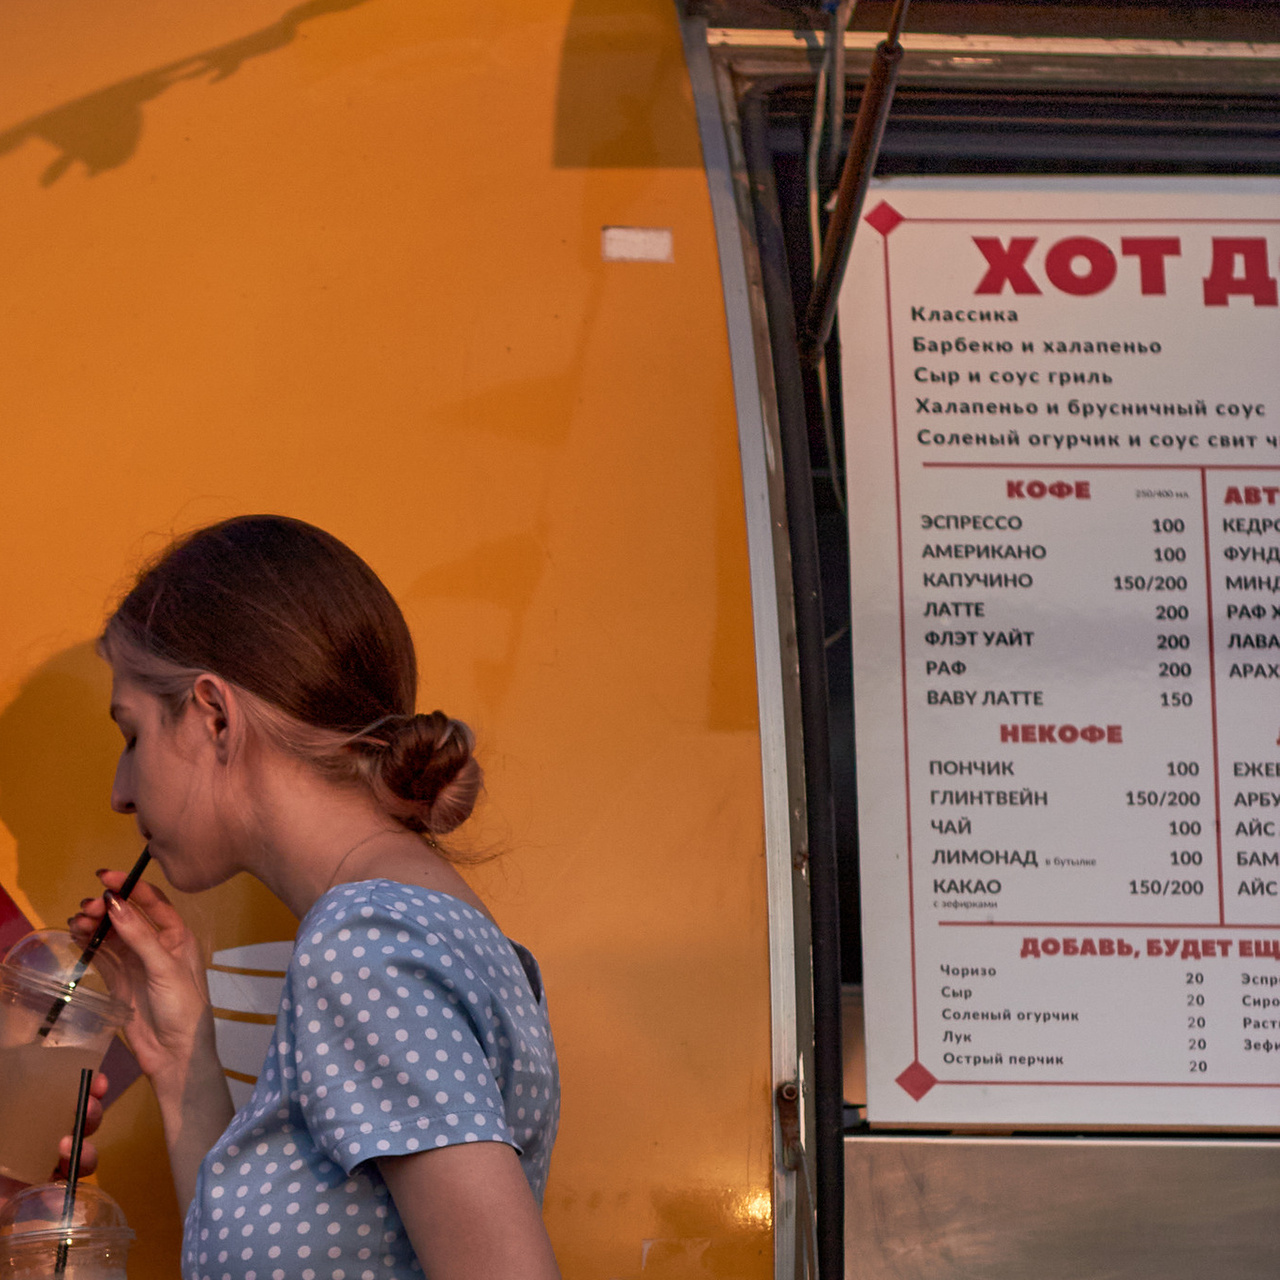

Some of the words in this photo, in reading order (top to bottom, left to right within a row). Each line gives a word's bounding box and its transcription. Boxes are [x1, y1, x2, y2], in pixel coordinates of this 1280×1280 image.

[971, 235, 1182, 297] ХОТ
[910, 305, 1019, 323] Классика
[912, 336, 1014, 356] Барбекю
[1021, 341, 1034, 354] и
[1043, 341, 1162, 354] халапеньо
[913, 366, 960, 387] Сыр
[968, 371, 981, 383] и
[988, 371, 1039, 387] соус
[1048, 371, 1113, 387] гриль
[915, 397, 1039, 415] Халапеньо
[1046, 402, 1059, 415] и
[1067, 398, 1207, 419] брусничный
[1215, 403, 1265, 420] соус
[916, 428, 1020, 446] Соленый
[1027, 434, 1120, 450] огурчик
[1128, 434, 1141, 447] и
[1149, 434, 1199, 451] соус
[1207, 435, 1257, 448] свит
[1006, 479, 1091, 500] КОФЕ
[921, 514, 1023, 531] ЭСПРЕССО
[1152, 518, 1186, 534] 100
[921, 543, 1047, 560] АМЕРИКАНО
[1154, 547, 1187, 563] 100
[1223, 546, 1280, 565] ФУНД
[923, 572, 1034, 589] КАПУЧИНО
[1113, 575, 1188, 592] 150/200
[923, 601, 985, 618] ЛАТТЕ
[1155, 605, 1190, 621] 200
[1226, 604, 1267, 620] РАФ
[924, 630, 979, 647] ФЛЭТ
[982, 628, 1035, 647] УАЙТ
[1157, 634, 1191, 650] 200
[925, 660, 967, 676] РАФ
[1158, 662, 1192, 678] 200
[1229, 662, 1280, 679] АРАХ
[981, 690, 1044, 706] ЛАТТЕ
[1160, 691, 1194, 707] 150
[999, 724, 1123, 744] НЕКОФЕ
[929, 760, 1015, 776] ПОНЧИК
[1167, 761, 1200, 777] 100
[930, 787, 1048, 806] ГЛИНТВЕЙН
[1125, 790, 1201, 807] 150/200
[1233, 791, 1280, 808] АРБУ
[930, 816, 972, 835] ЧАЙ
[1169, 820, 1202, 836] 100
[1235, 818, 1275, 837] АЙС
[931, 849, 1039, 868] ЛИМОНАД
[1053, 856, 1097, 868] бутылке
[1170, 850, 1203, 866] 100
[1236, 851, 1280, 867] БАМ
[933, 878, 1002, 895] КАКАО
[1129, 879, 1204, 896] 150/200
[1237, 877, 1278, 897] АЙС
[1019, 937, 1141, 959] ДОБАВЬ,
[1146, 938, 1234, 961] БУДЕТ
[939, 963, 997, 979] Чоризо
[1186, 972, 1205, 985] 20
[1241, 972, 1280, 988] Эспр
[940, 985, 973, 1001] Сыр
[1187, 993, 1205, 1007] 20
[941, 1007, 1012, 1021] Соленый
[1016, 1011, 1079, 1024] огурчик
[1187, 1015, 1206, 1029] 20
[1242, 1016, 1280, 1030] Раст
[942, 1030, 972, 1045] Лук
[1188, 1038, 1207, 1051] 20
[942, 1052, 1004, 1067] Острый
[1008, 1055, 1064, 1068] перчик
[1189, 1060, 1208, 1073] 20
